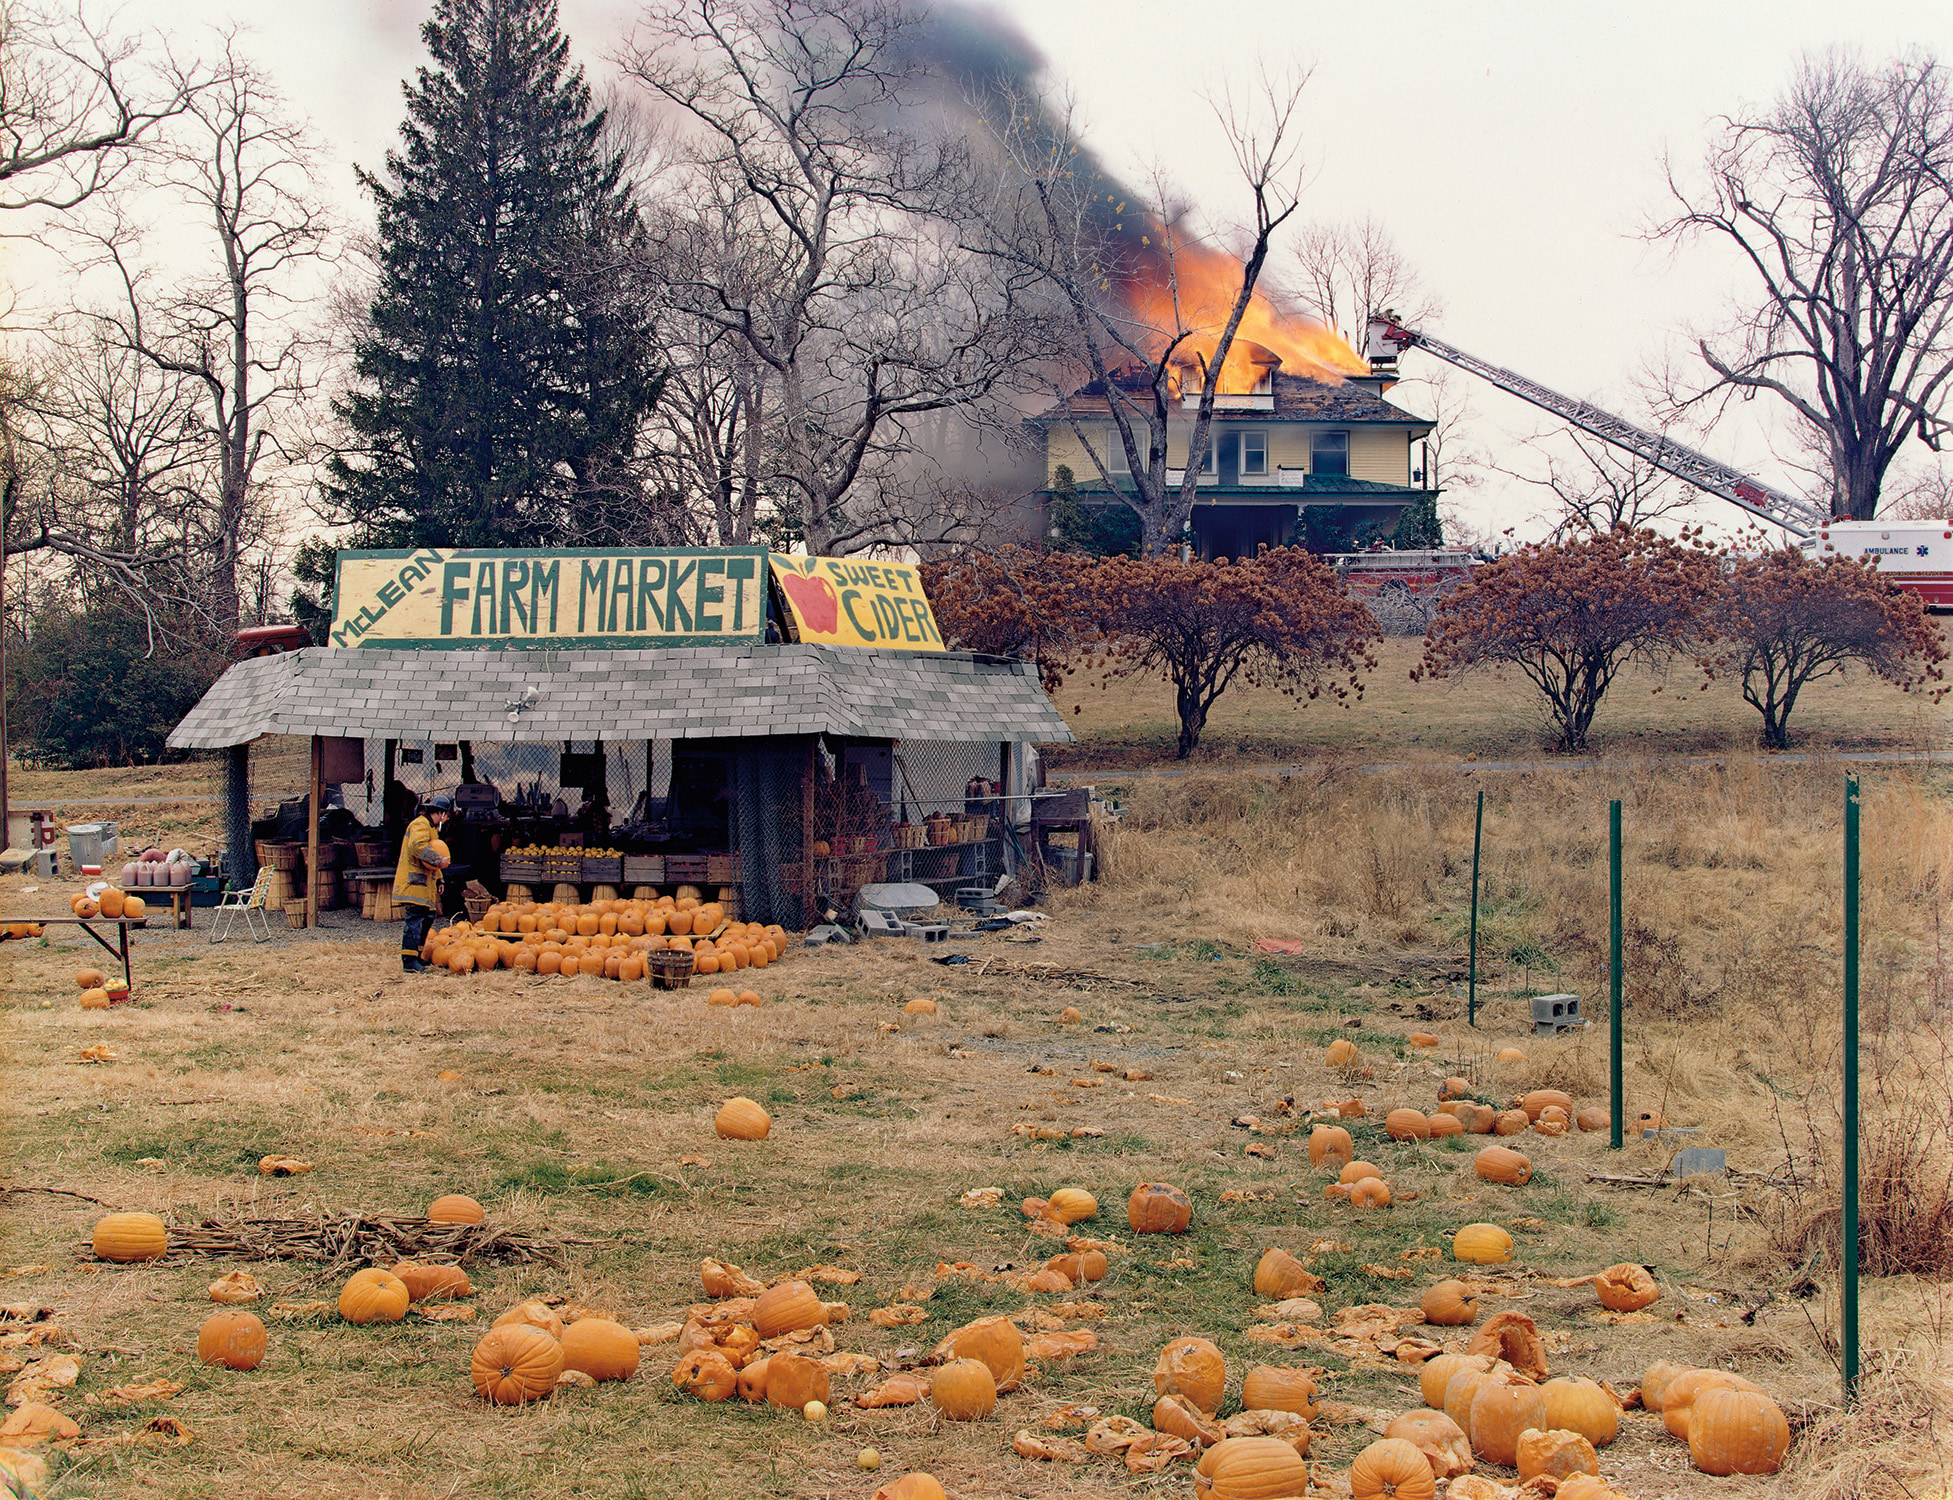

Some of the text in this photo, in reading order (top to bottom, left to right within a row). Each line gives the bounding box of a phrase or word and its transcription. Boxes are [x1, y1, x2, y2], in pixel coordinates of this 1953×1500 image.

[1864, 547, 1909, 555] AMBULANCE
[440, 558, 755, 635] FARM MARKET
[826, 561, 913, 593] SWEET
[841, 589, 941, 643] CIDER
